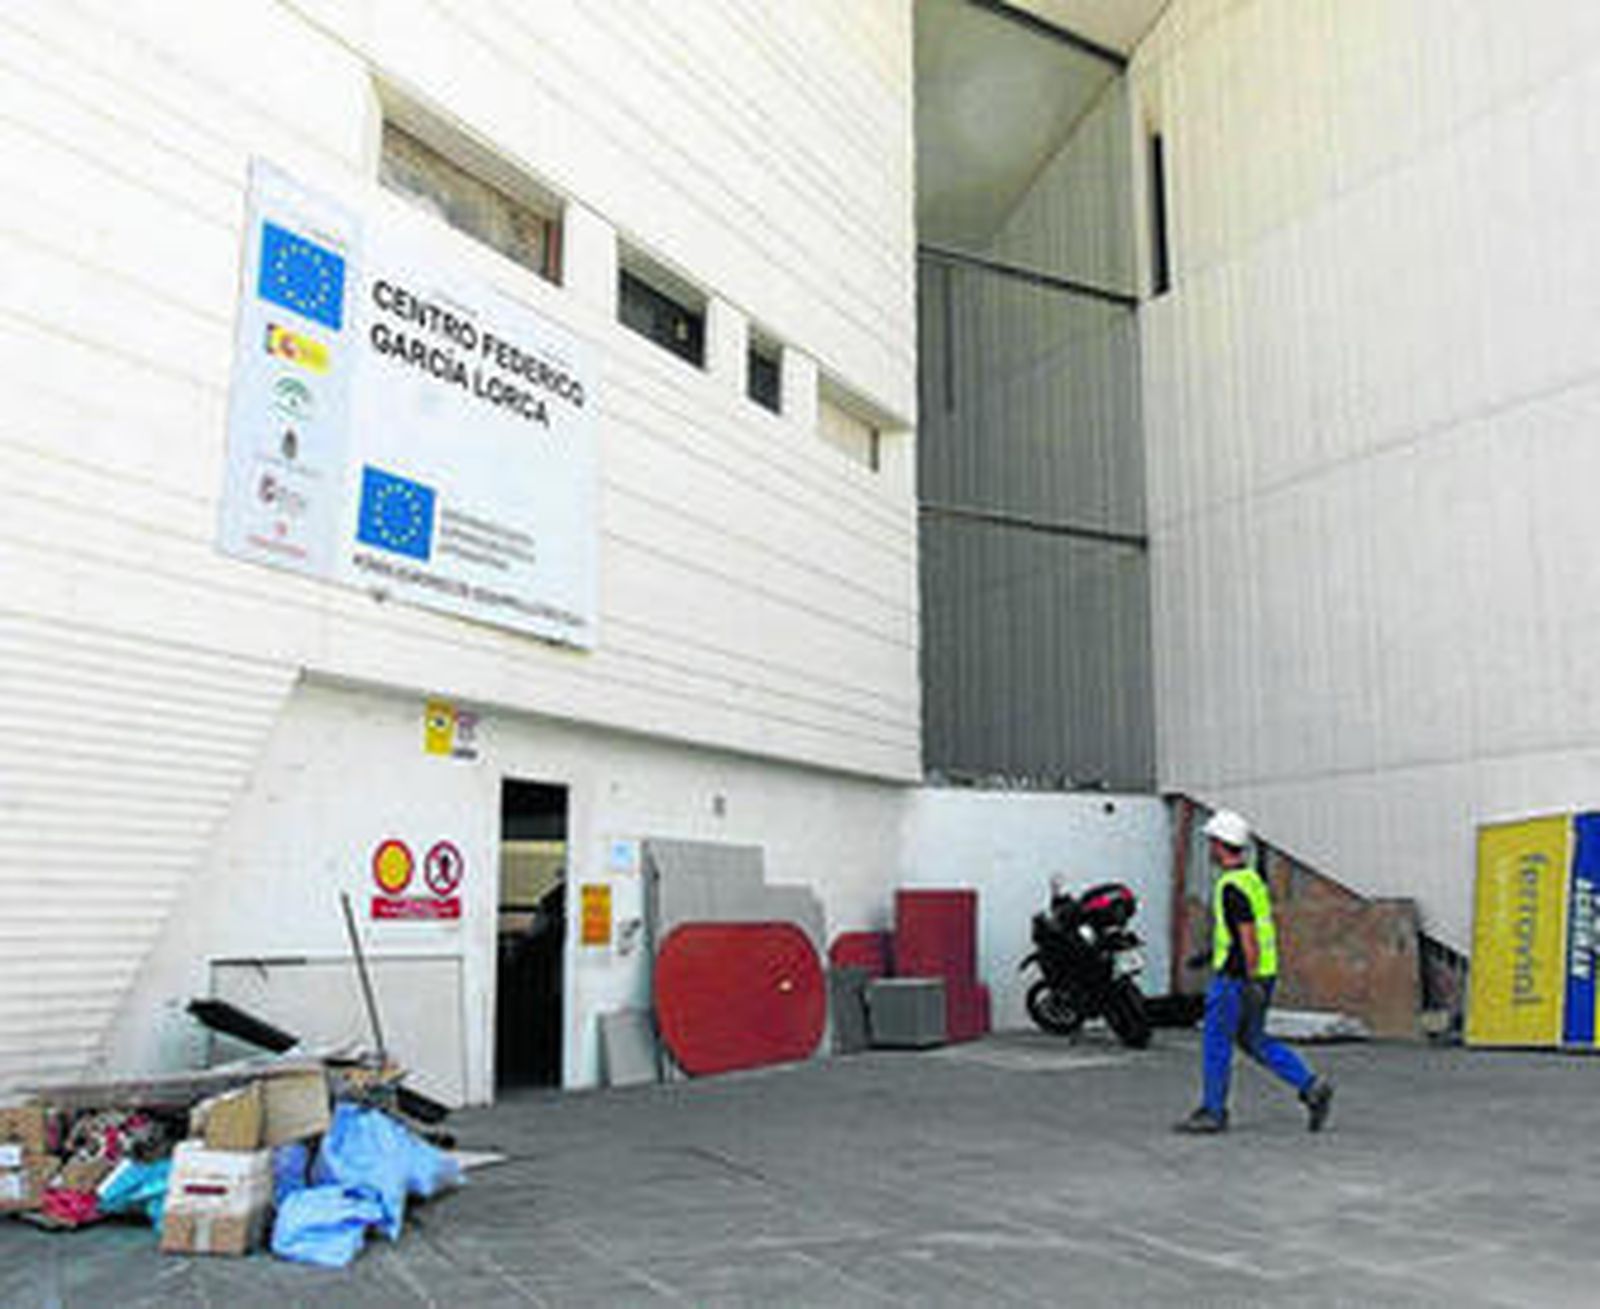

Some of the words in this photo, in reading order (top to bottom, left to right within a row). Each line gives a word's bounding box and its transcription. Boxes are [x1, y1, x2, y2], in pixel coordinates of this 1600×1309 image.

[369, 321, 470, 391] GARCÍA
[472, 366, 551, 430] LORCA
[371, 278, 479, 351] CENTRO
[481, 331, 586, 408] FEDERICO
[1511, 852, 1549, 1005] ferrovial
